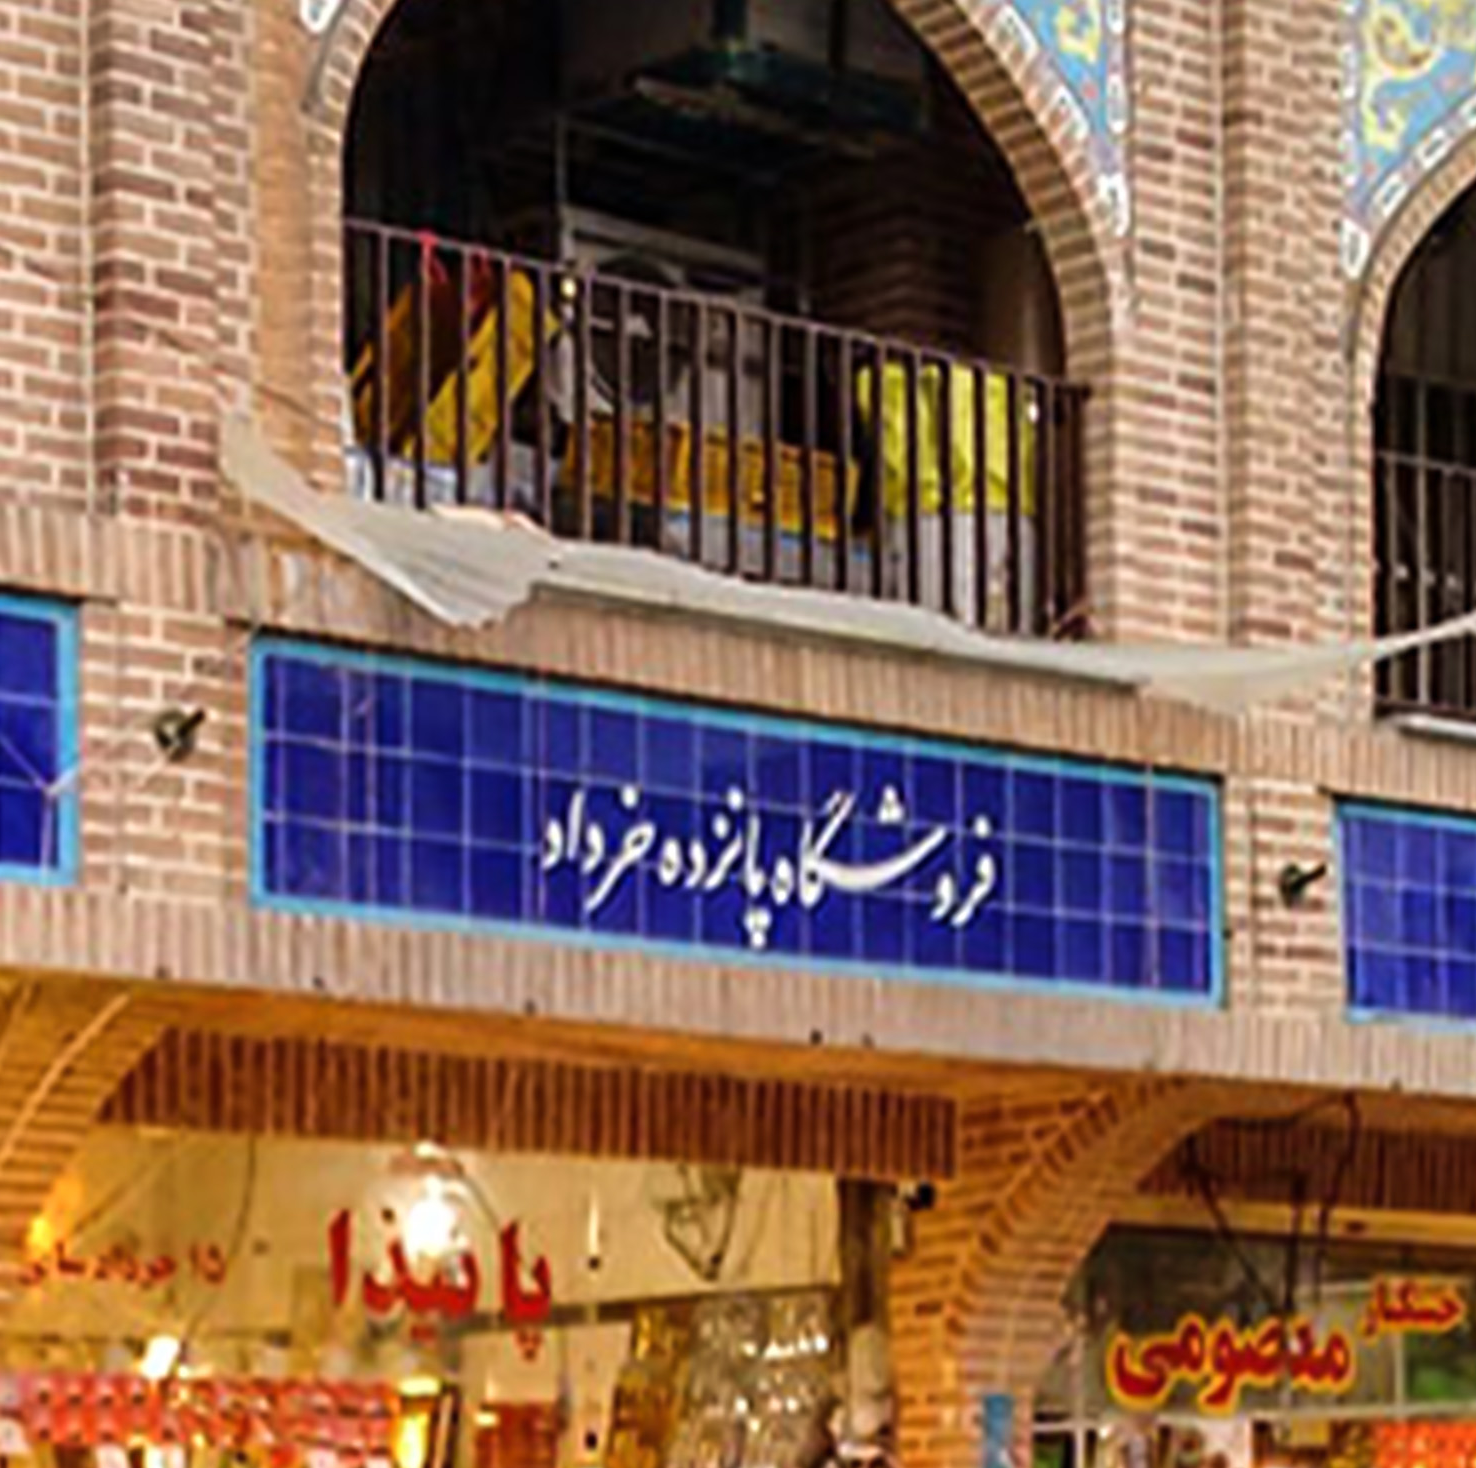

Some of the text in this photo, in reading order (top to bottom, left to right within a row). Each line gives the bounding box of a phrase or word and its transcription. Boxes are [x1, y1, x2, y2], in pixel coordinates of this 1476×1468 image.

[540, 782, 996, 949] فروشگاه پانزده خرداد
